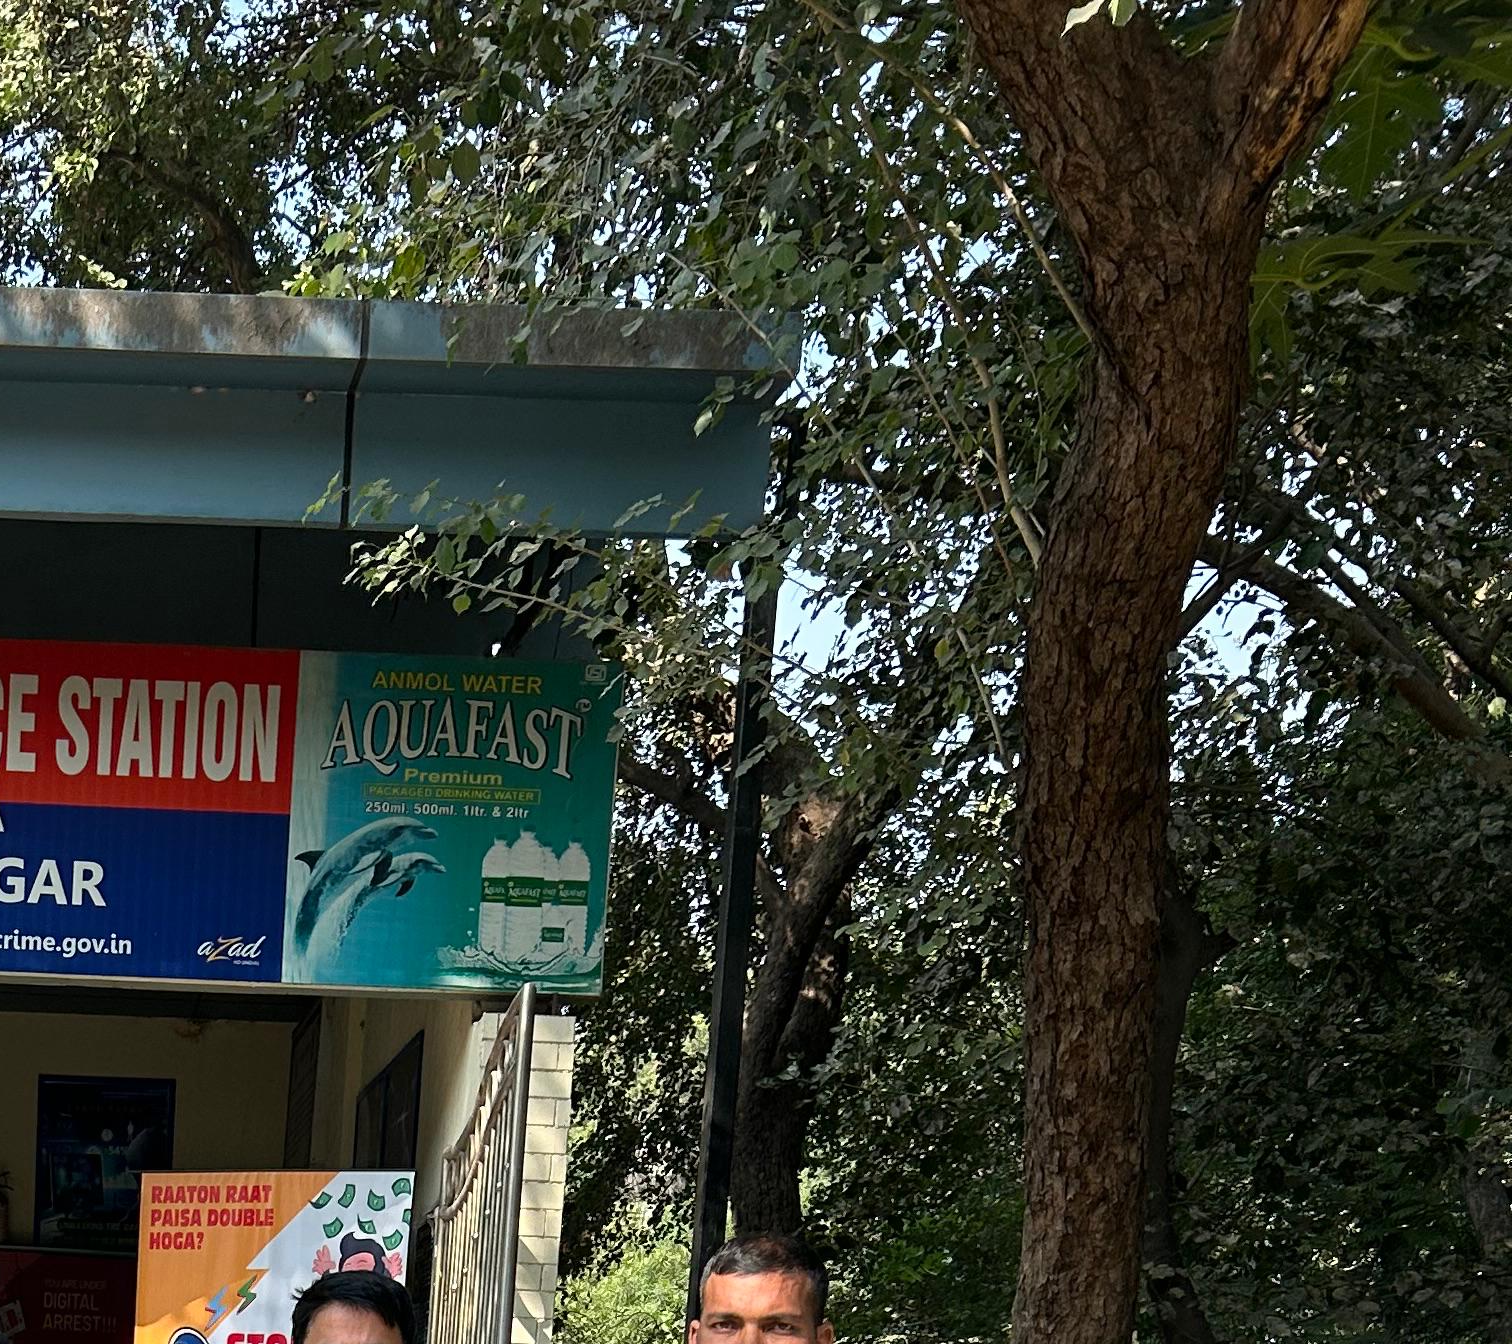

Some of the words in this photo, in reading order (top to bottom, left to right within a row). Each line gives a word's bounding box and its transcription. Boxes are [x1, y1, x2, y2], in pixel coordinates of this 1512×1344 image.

[372, 671, 455, 692] ANMOL
[462, 674, 543, 695] WATER
[55, 673, 281, 784] STATION
[320, 696, 583, 780] AQUAFAST
[404, 767, 504, 785] Premium
[367, 785, 432, 799] PACKAGED
[434, 787, 491, 801] DRINKING
[494, 790, 535, 802] WATER
[491, 806, 502, 817] &
[151, 1185, 221, 1204] RAATON
[226, 1185, 272, 1203] RAAT
[150, 1208, 202, 1227] PAISA
[207, 1208, 274, 1227] DOUBLE
[149, 1231, 205, 1250] HOGA?
[42, 1291, 100, 1311] DIGITAL
[42, 1312, 118, 1334] ARREST!!!
